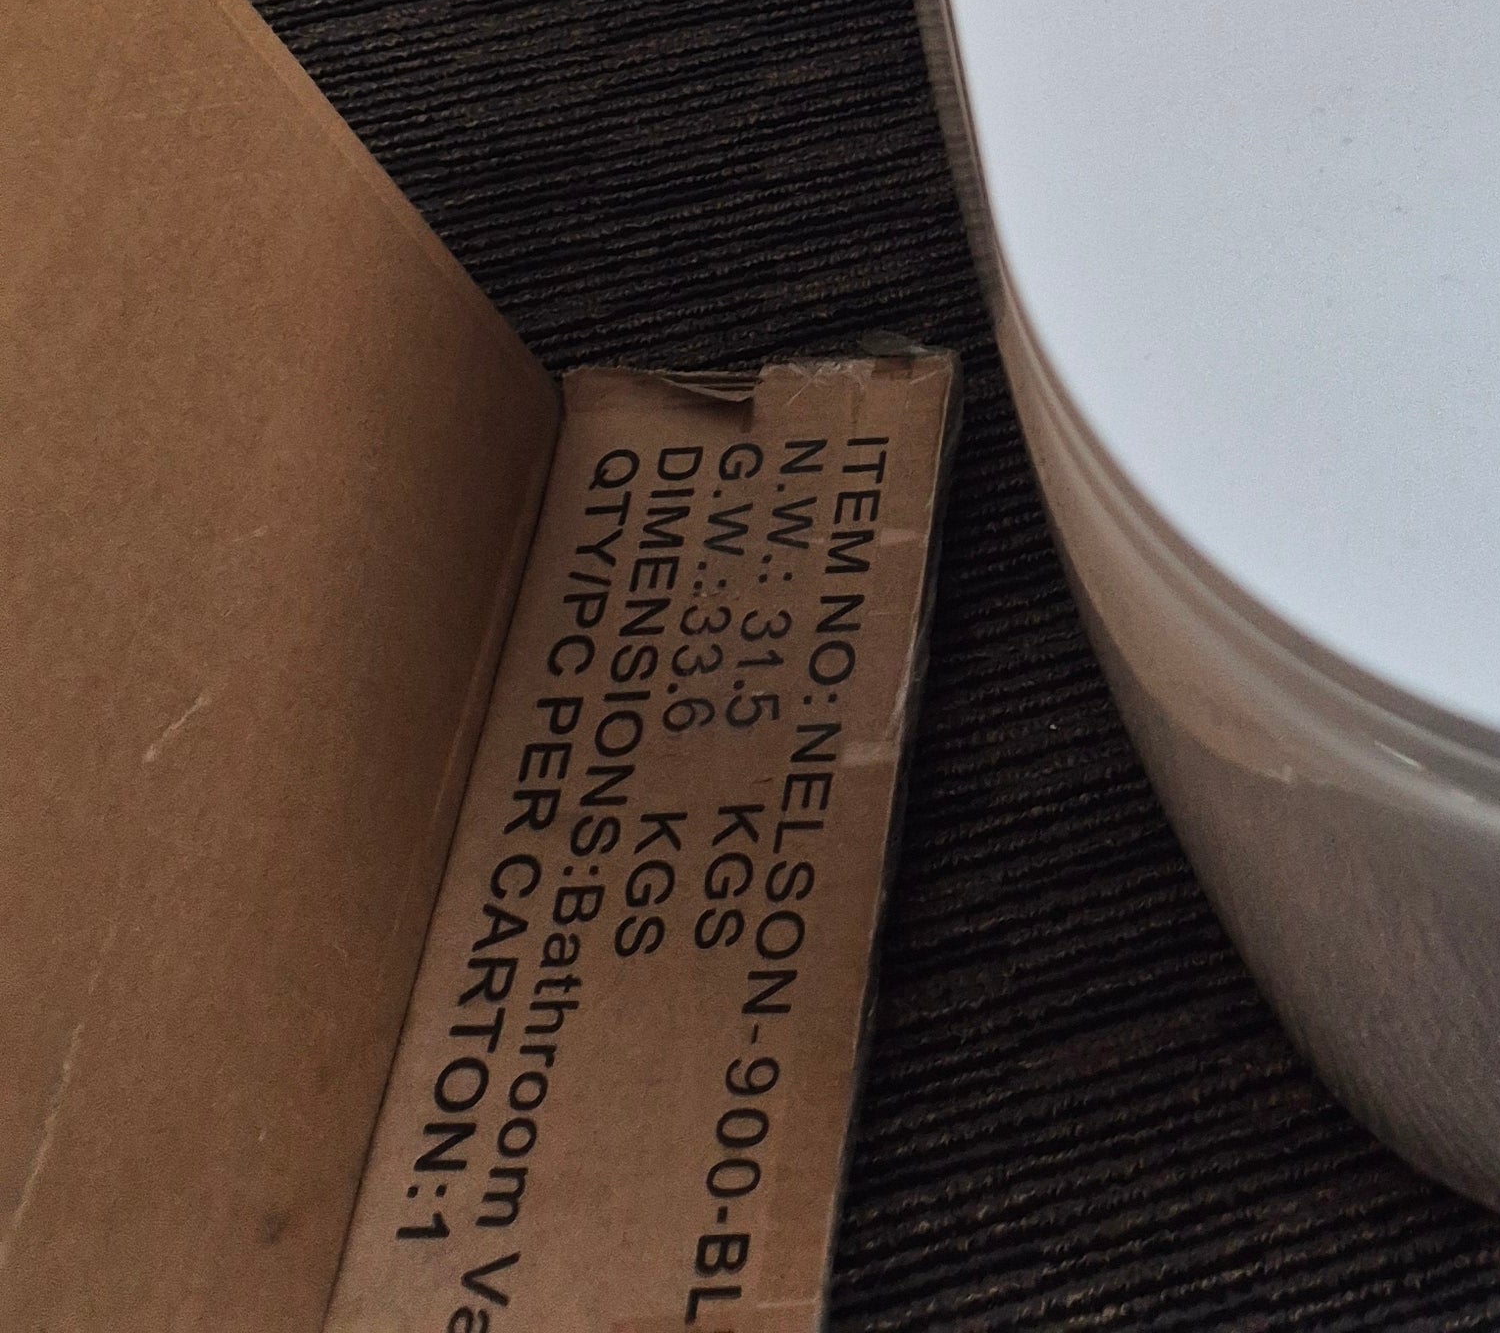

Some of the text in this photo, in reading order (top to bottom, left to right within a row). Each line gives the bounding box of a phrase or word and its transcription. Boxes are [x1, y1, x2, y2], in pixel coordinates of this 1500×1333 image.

[825, 436, 890, 575] ITEM
[395, 448, 641, 1241] QTY/PC PER CARTON:1
[692, 438, 829, 950] N.W.: 31.5 KGS
[612, 810, 689, 959] KGS
